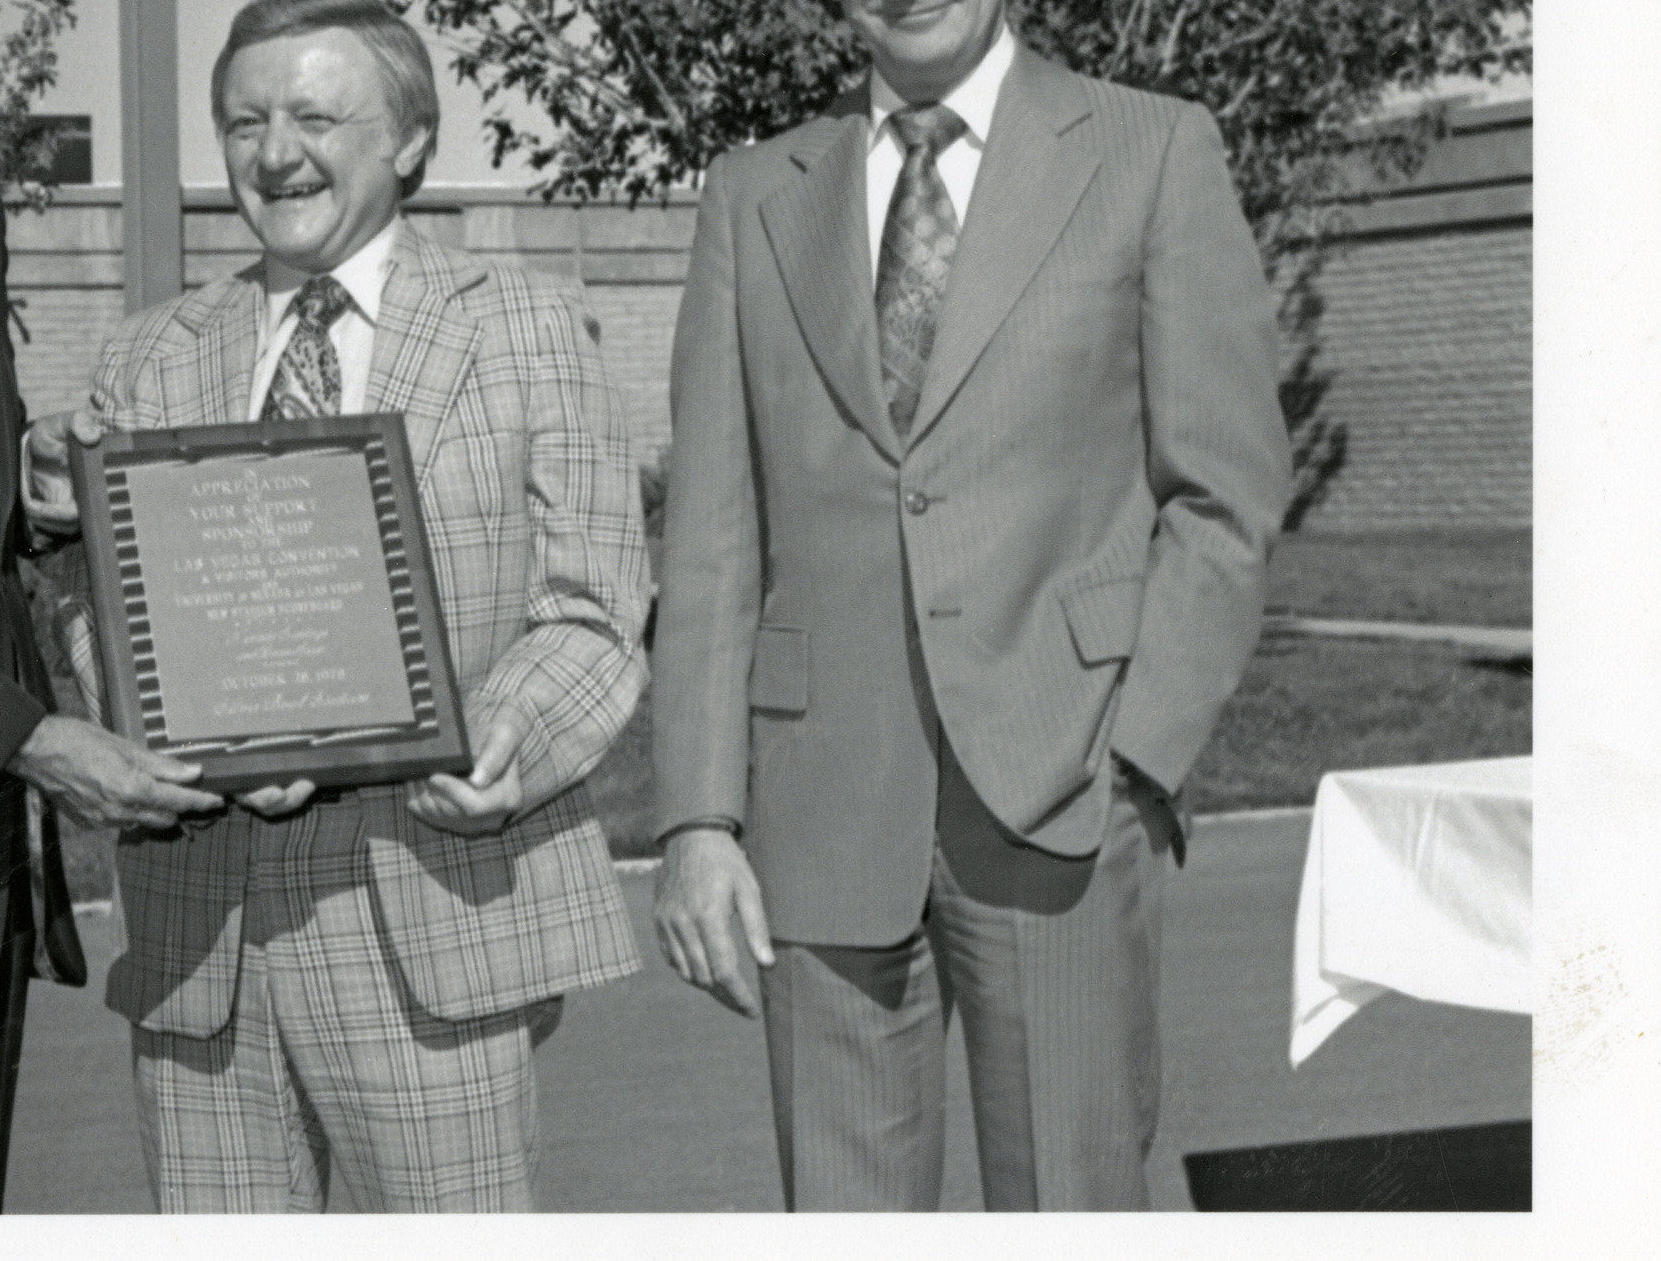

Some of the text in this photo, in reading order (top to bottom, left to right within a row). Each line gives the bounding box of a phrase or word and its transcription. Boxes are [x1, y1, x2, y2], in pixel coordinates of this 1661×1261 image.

[190, 475, 311, 498] APPRECIATION
[189, 498, 317, 521] YOUR SUPPORT
[266, 545, 360, 566] CONVENTION
